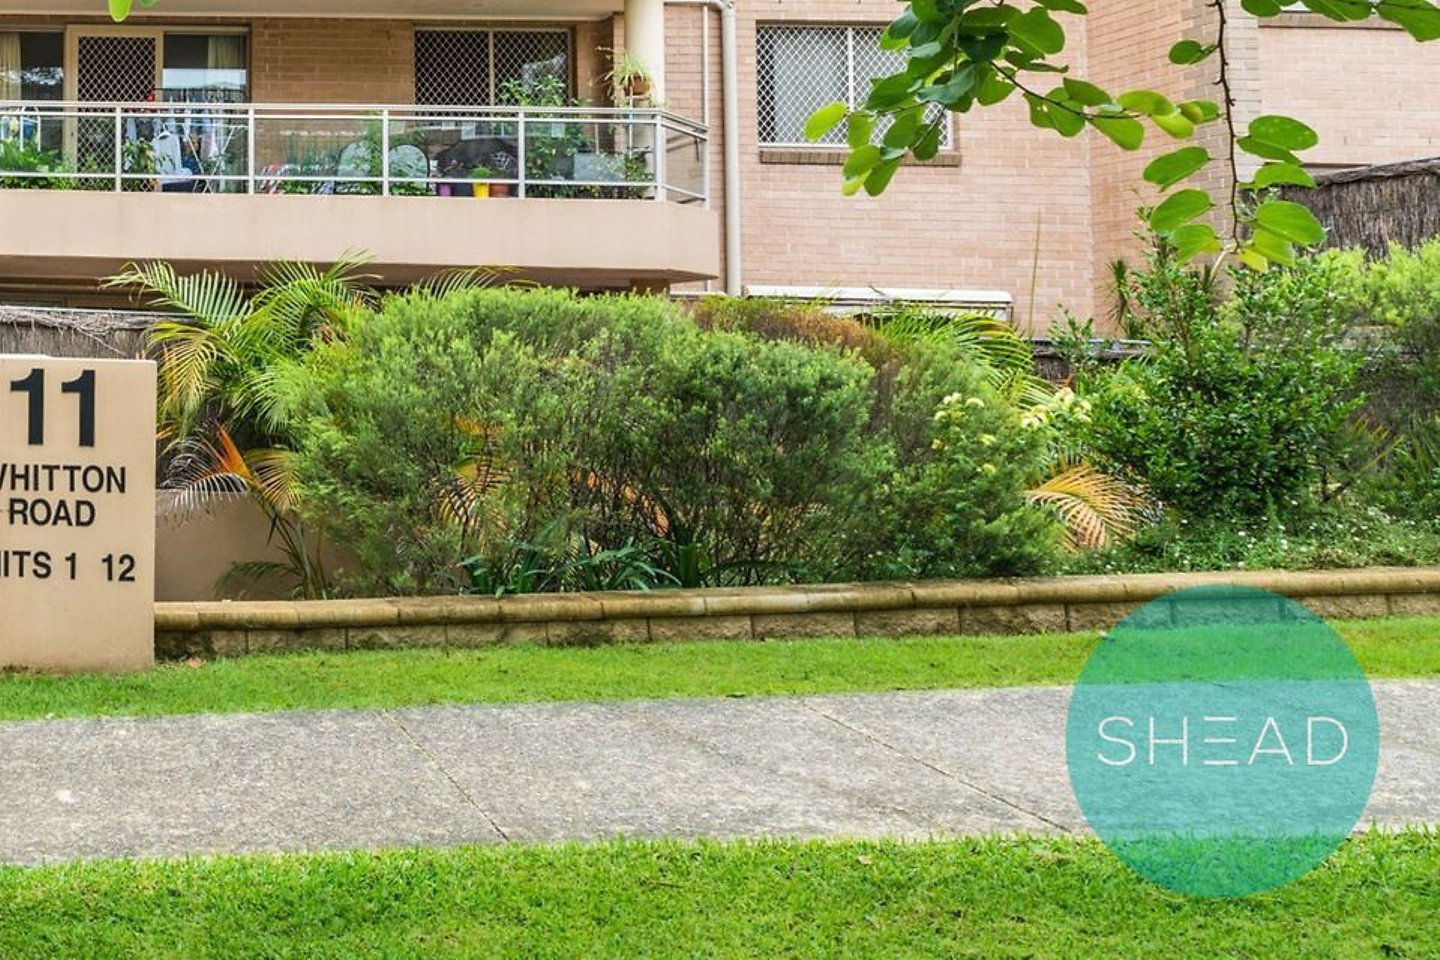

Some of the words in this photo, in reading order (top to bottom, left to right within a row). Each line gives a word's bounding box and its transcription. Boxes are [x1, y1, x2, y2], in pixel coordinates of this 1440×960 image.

[10, 368, 96, 447] 11
[9, 498, 96, 527] ROAD
[65, 552, 77, 580] 1
[101, 554, 136, 582] 12
